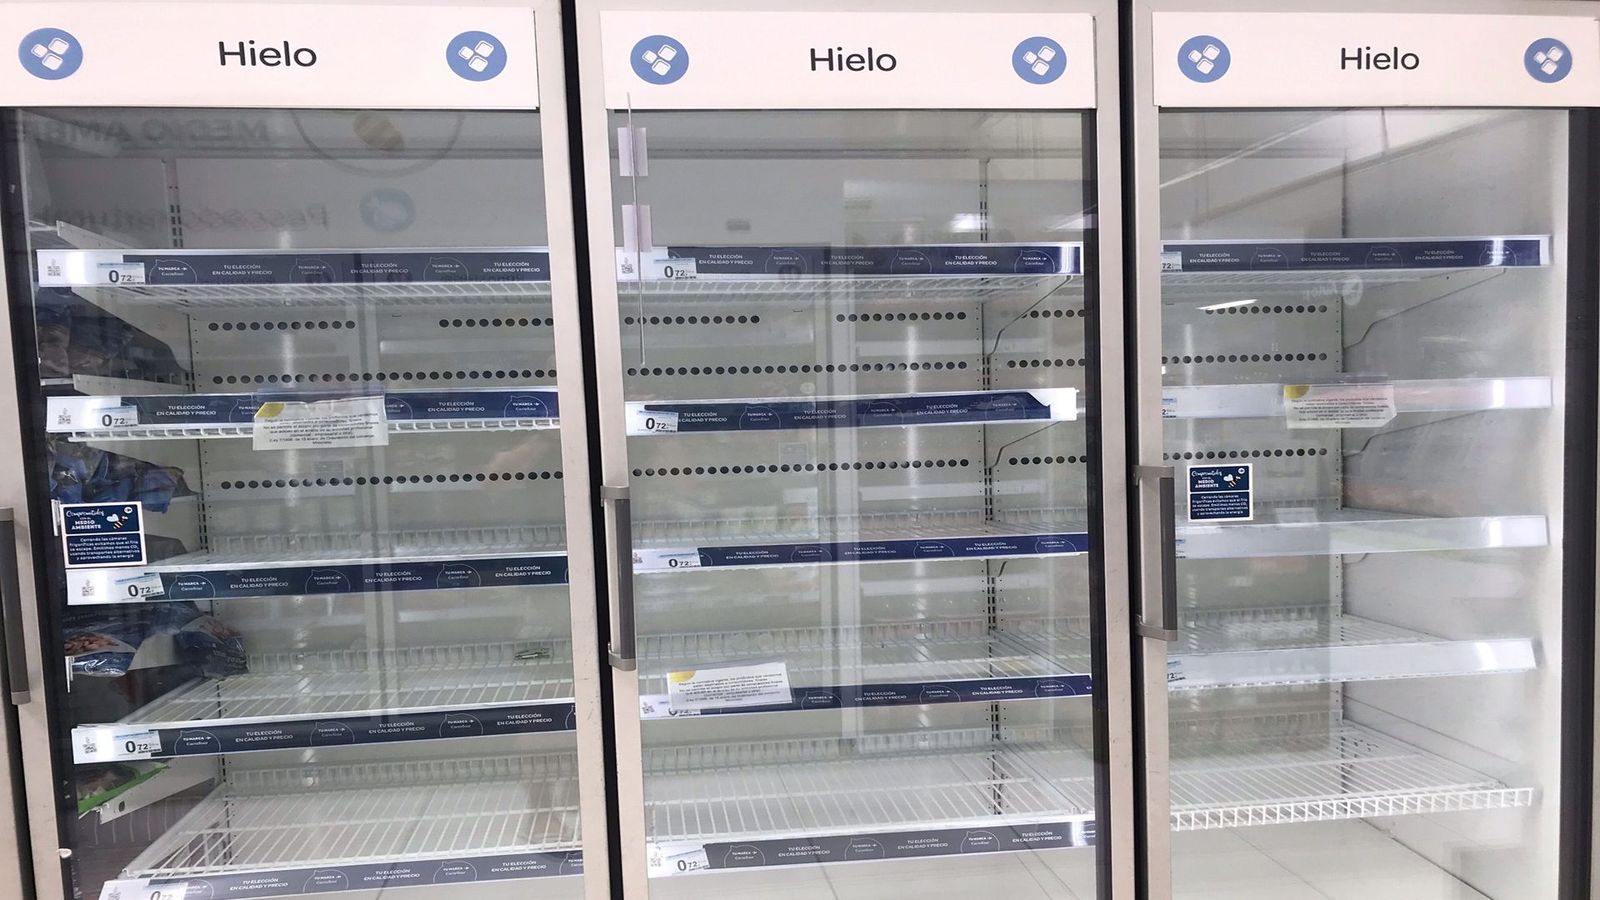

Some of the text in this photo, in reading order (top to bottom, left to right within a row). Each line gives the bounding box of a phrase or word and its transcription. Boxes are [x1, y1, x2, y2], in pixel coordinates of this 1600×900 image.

[219, 41, 316, 66] Hielo
[811, 47, 896, 71] Hielo
[1342, 47, 1419, 69] Hielo
